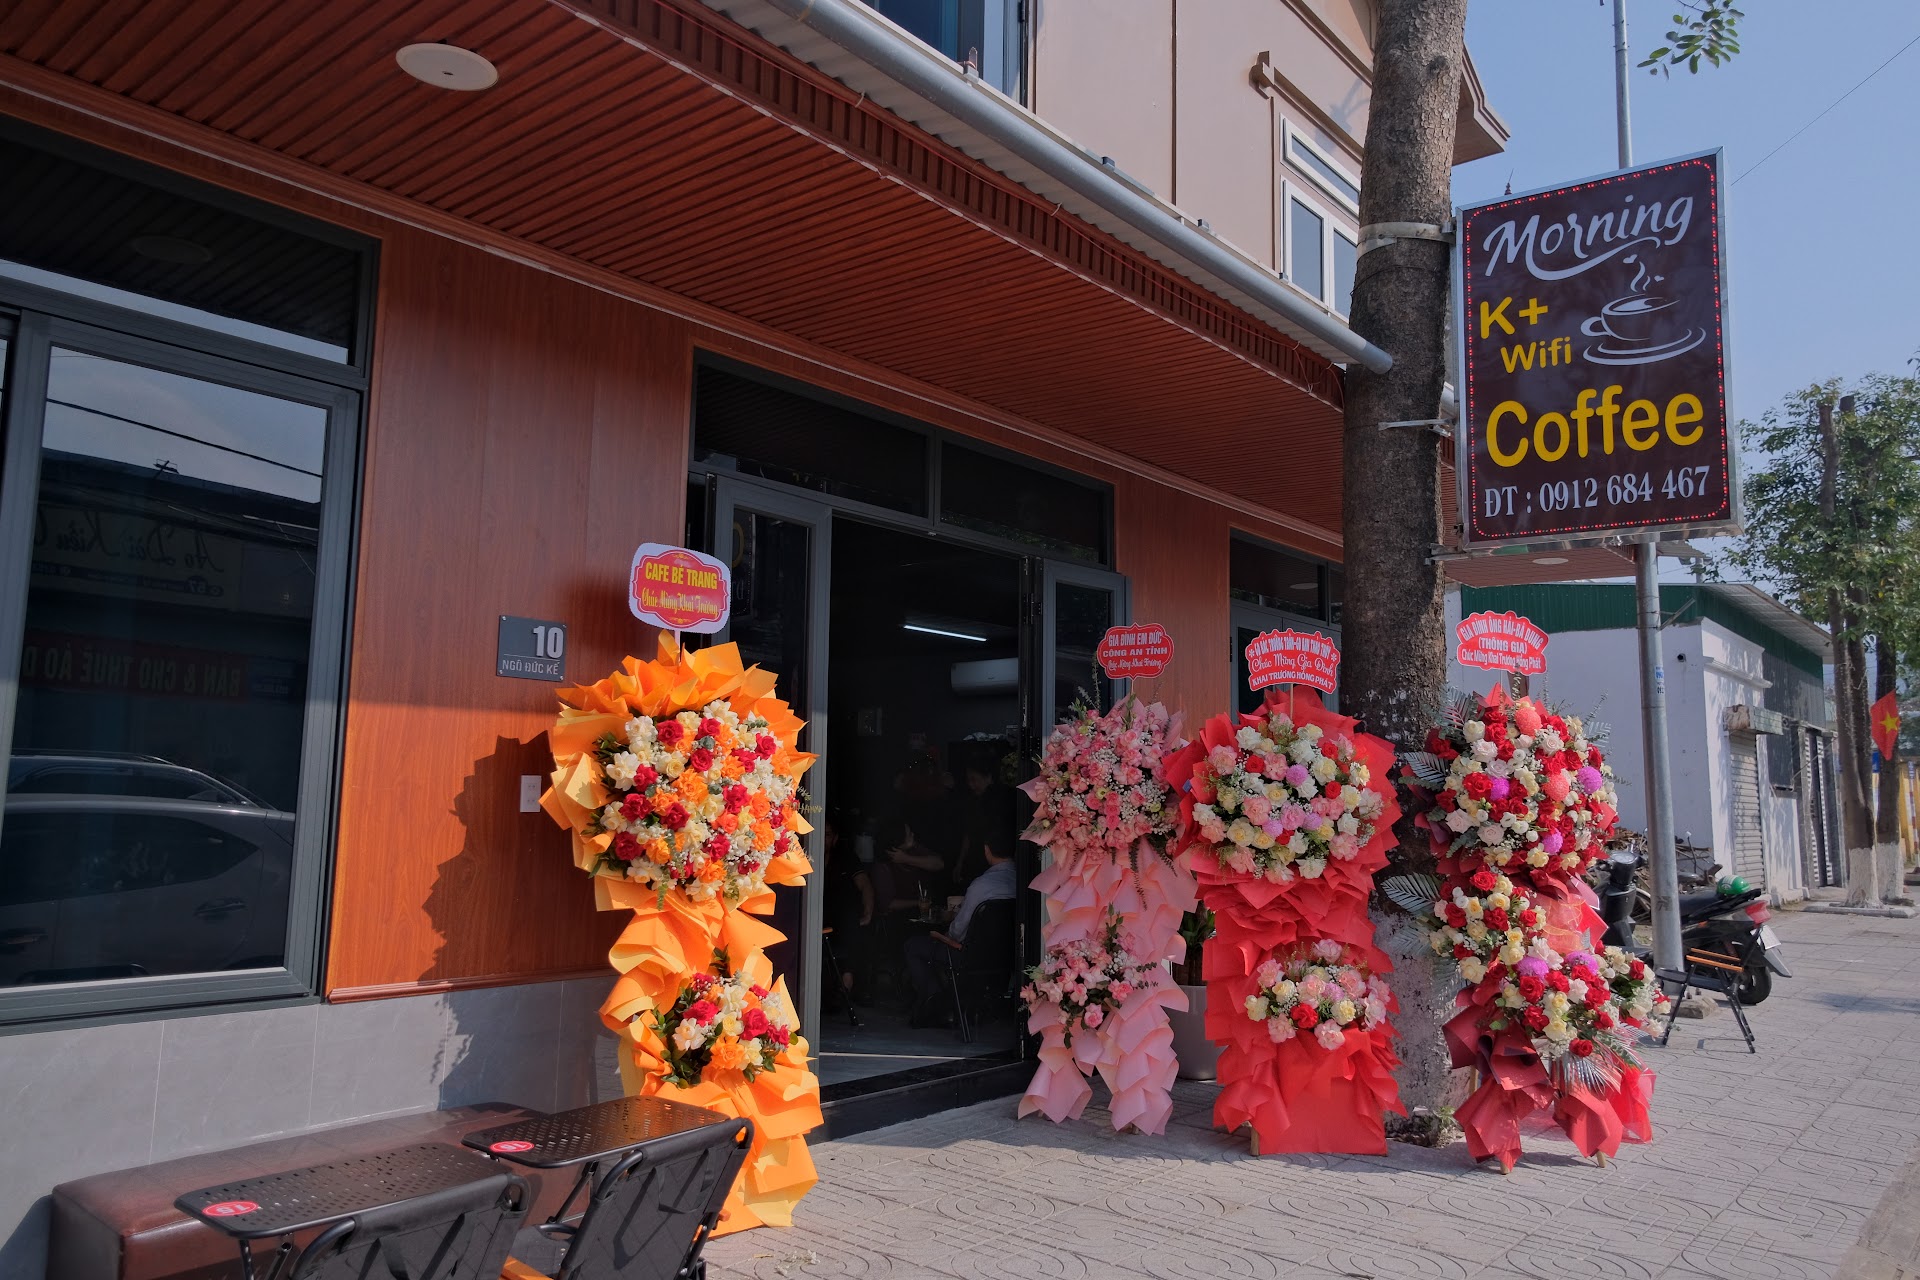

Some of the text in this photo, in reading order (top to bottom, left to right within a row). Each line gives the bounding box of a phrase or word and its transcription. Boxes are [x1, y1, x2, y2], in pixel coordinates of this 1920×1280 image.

[1483, 194, 1693, 281] Morning
[1480, 296, 1549, 339] K+
[1500, 336, 1572, 374] Wifi
[1486, 384, 1704, 468] Coffee
[1539, 477, 1599, 512] 0912
[1606, 472, 1653, 506] 684
[1661, 465, 1710, 500] 467
[645, 562, 670, 583] CAFE
[672, 564, 684, 585] BÉ
[686, 568, 718, 590] TRANG
[1108, 634, 1119, 647] GIA
[1120, 631, 1135, 646] ĐÌNH
[1137, 632, 1148, 645] EM
[1460, 624, 1474, 641] GIA
[1472, 618, 1489, 635] ĐÌNH
[1489, 616, 1502, 633] ÔNG
[533, 625, 564, 659] 10
[1102, 648, 1127, 658] CÔNG
[1129, 648, 1143, 656] AN
[1478, 637, 1527, 654] (THÔNG GIA)
[502, 659, 561, 675] NGÔ ĐỨC KẾ
[1252, 656, 1273, 673] Chúc
[1252, 673, 1269, 686] KHAI
[1315, 676, 1334, 690] PHÁT
